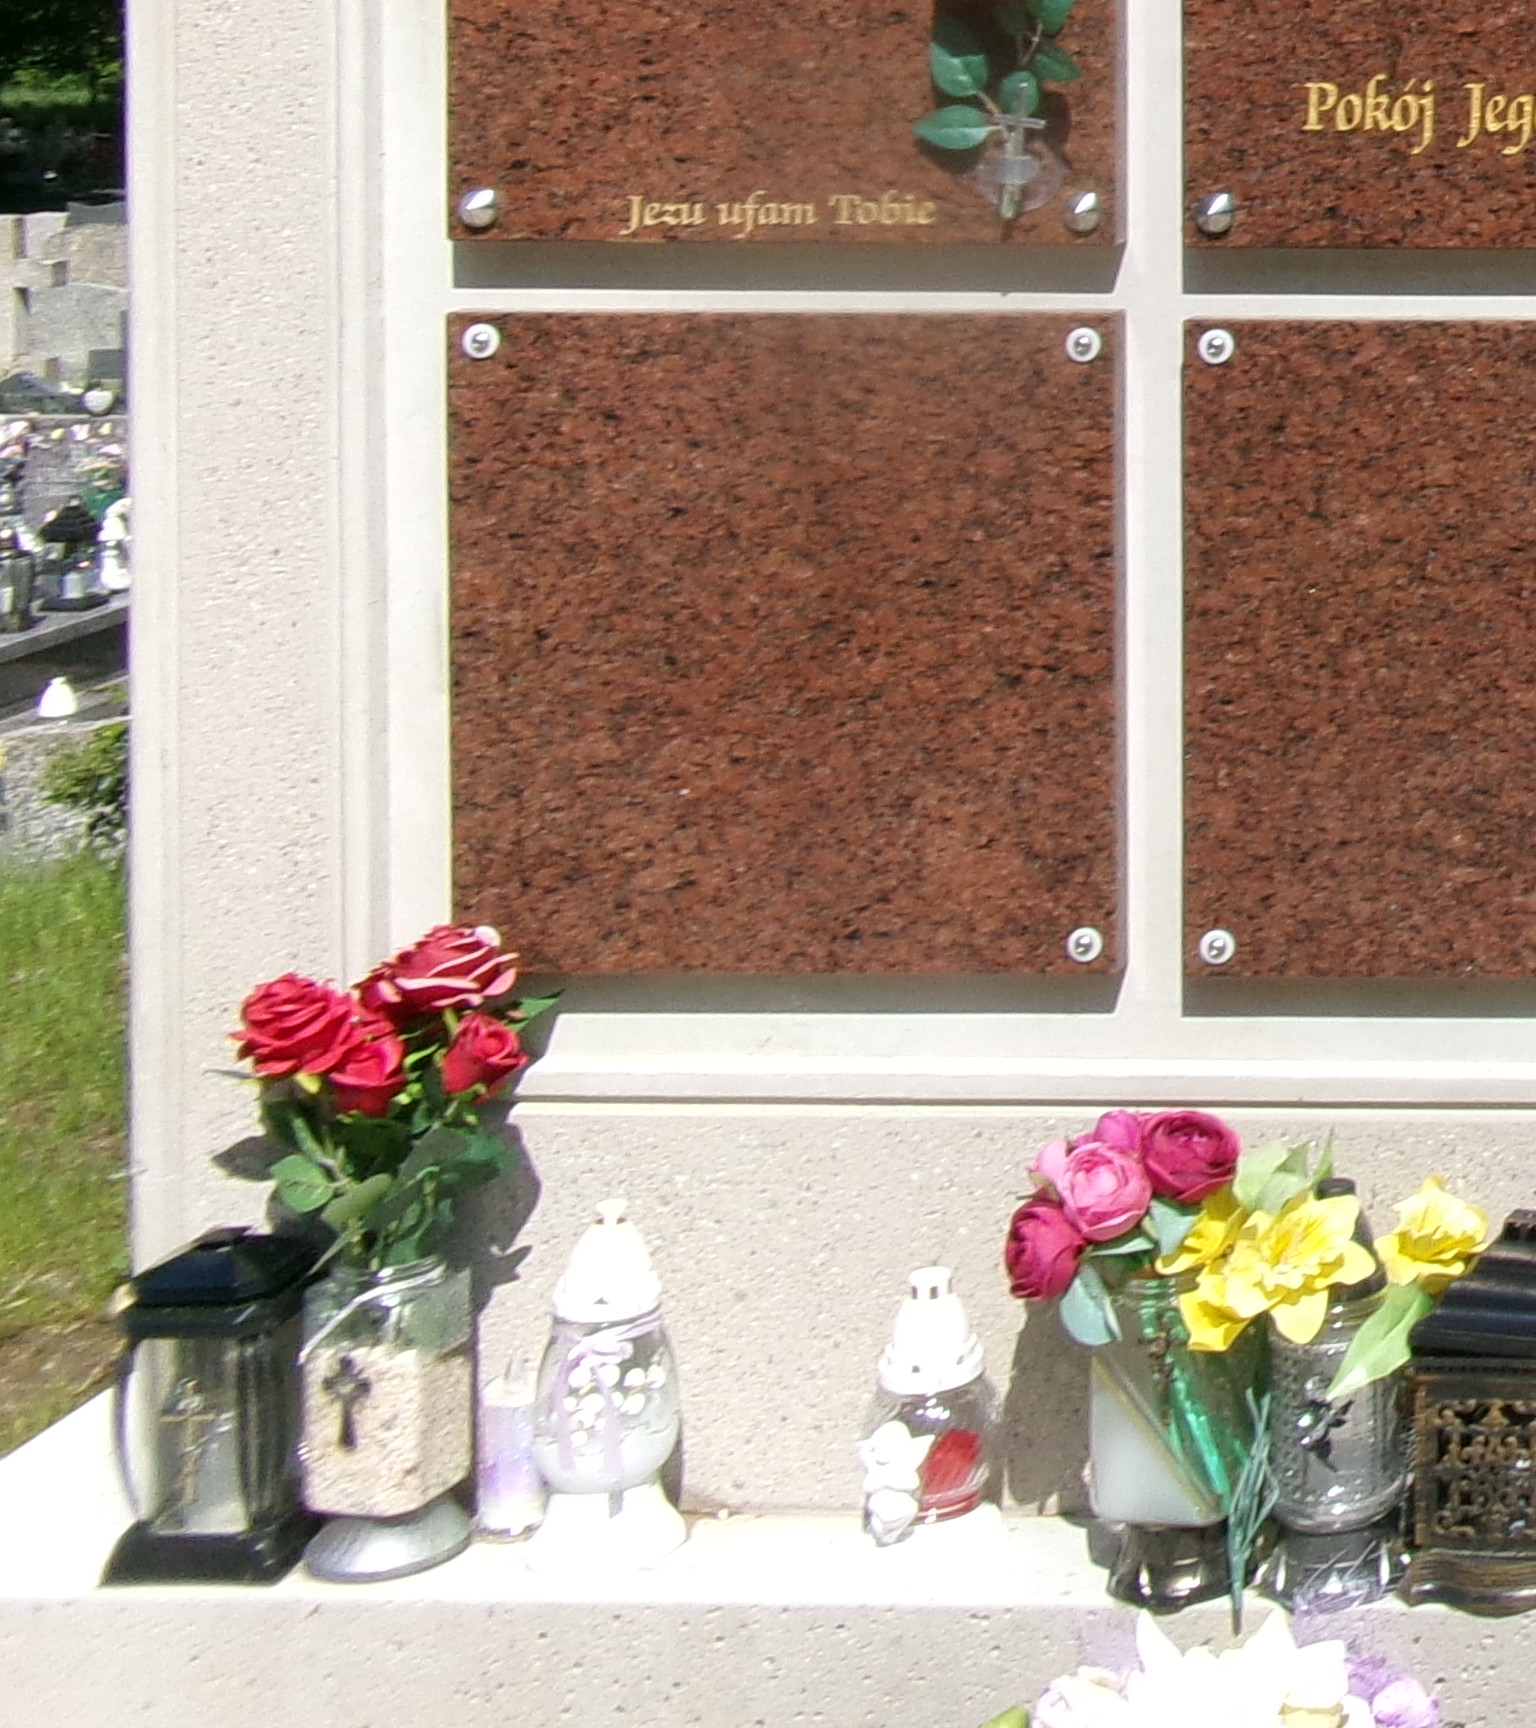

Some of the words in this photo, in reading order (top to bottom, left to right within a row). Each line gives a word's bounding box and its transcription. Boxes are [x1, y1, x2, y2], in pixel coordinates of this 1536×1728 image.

[1302, 74, 1437, 154] Pokój
[619, 194, 707, 235] Jezu
[718, 190, 818, 239] ufam
[828, 190, 938, 226] Tobie
